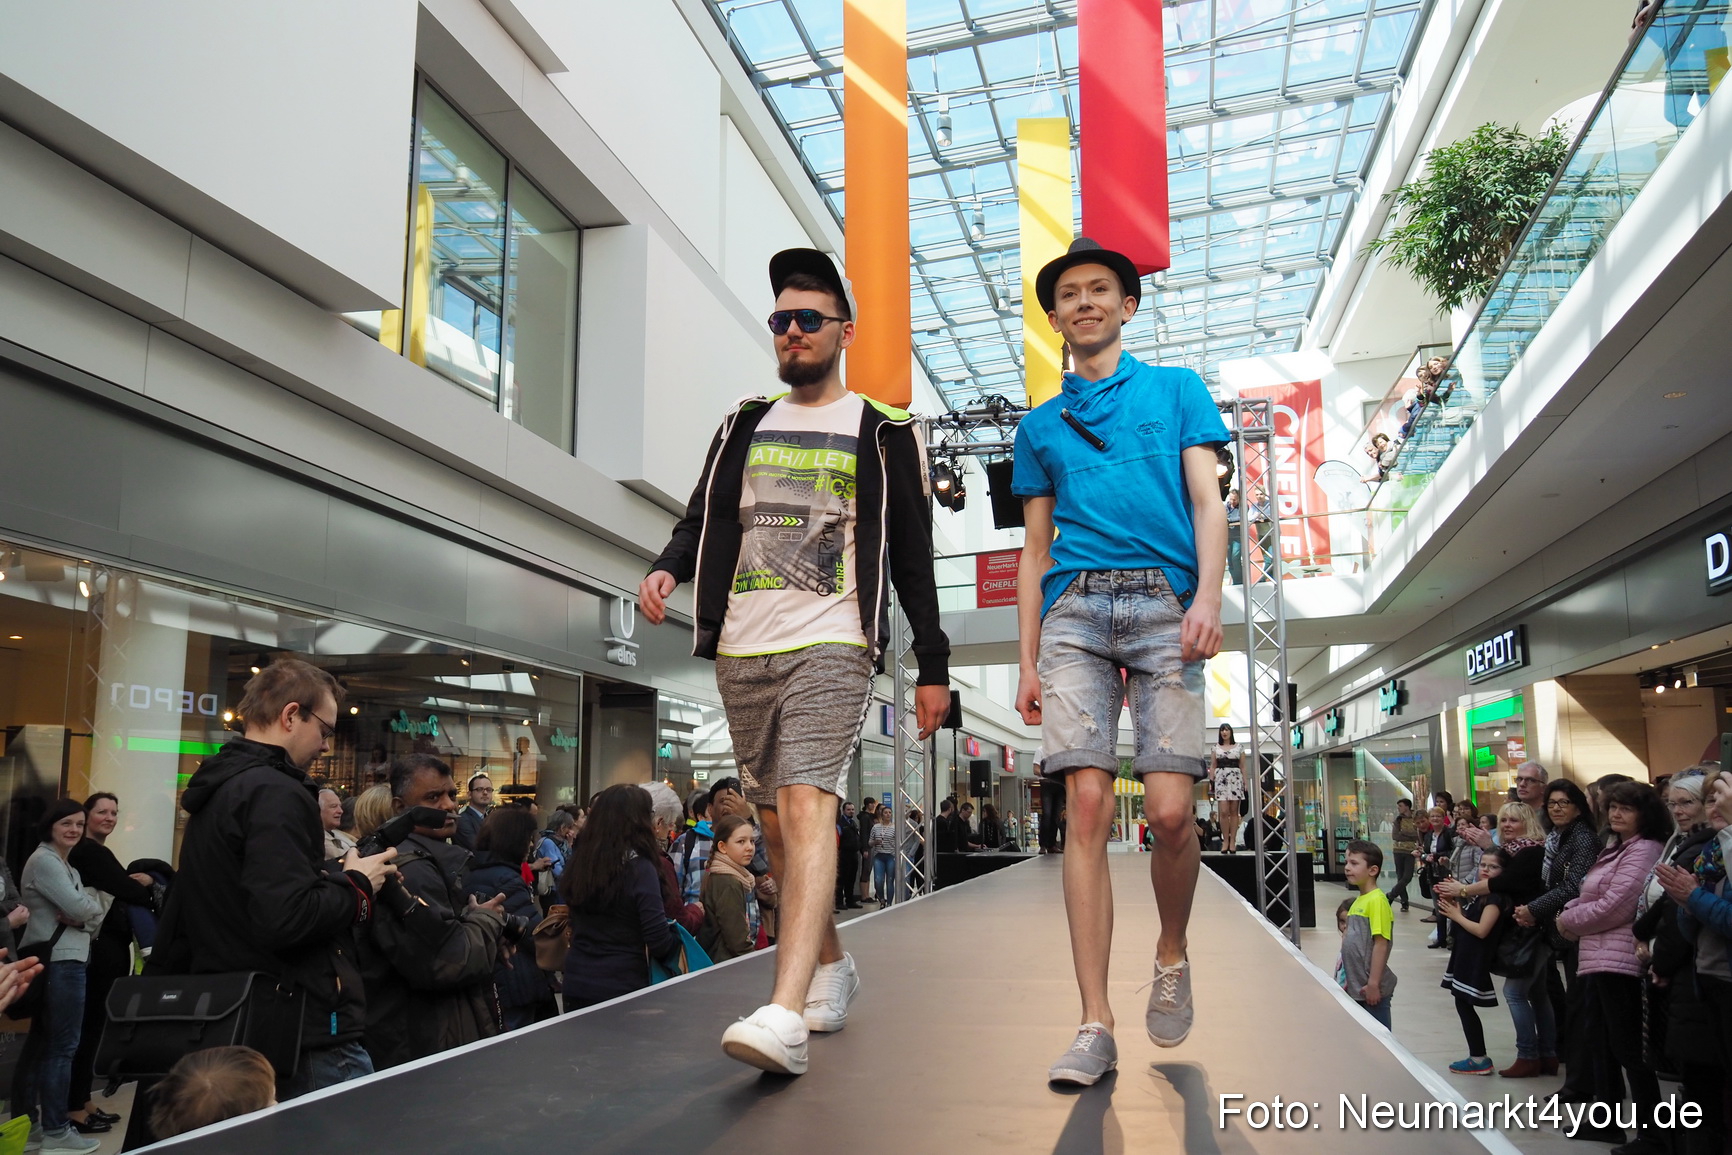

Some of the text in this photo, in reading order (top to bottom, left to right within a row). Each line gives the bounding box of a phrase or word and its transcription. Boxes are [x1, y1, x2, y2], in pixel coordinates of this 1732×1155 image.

[753, 433, 801, 445] RBAN
[815, 508, 842, 597] OVERKILL
[982, 580, 1017, 591] CINEPLE
[1466, 630, 1514, 676] DEPOT
